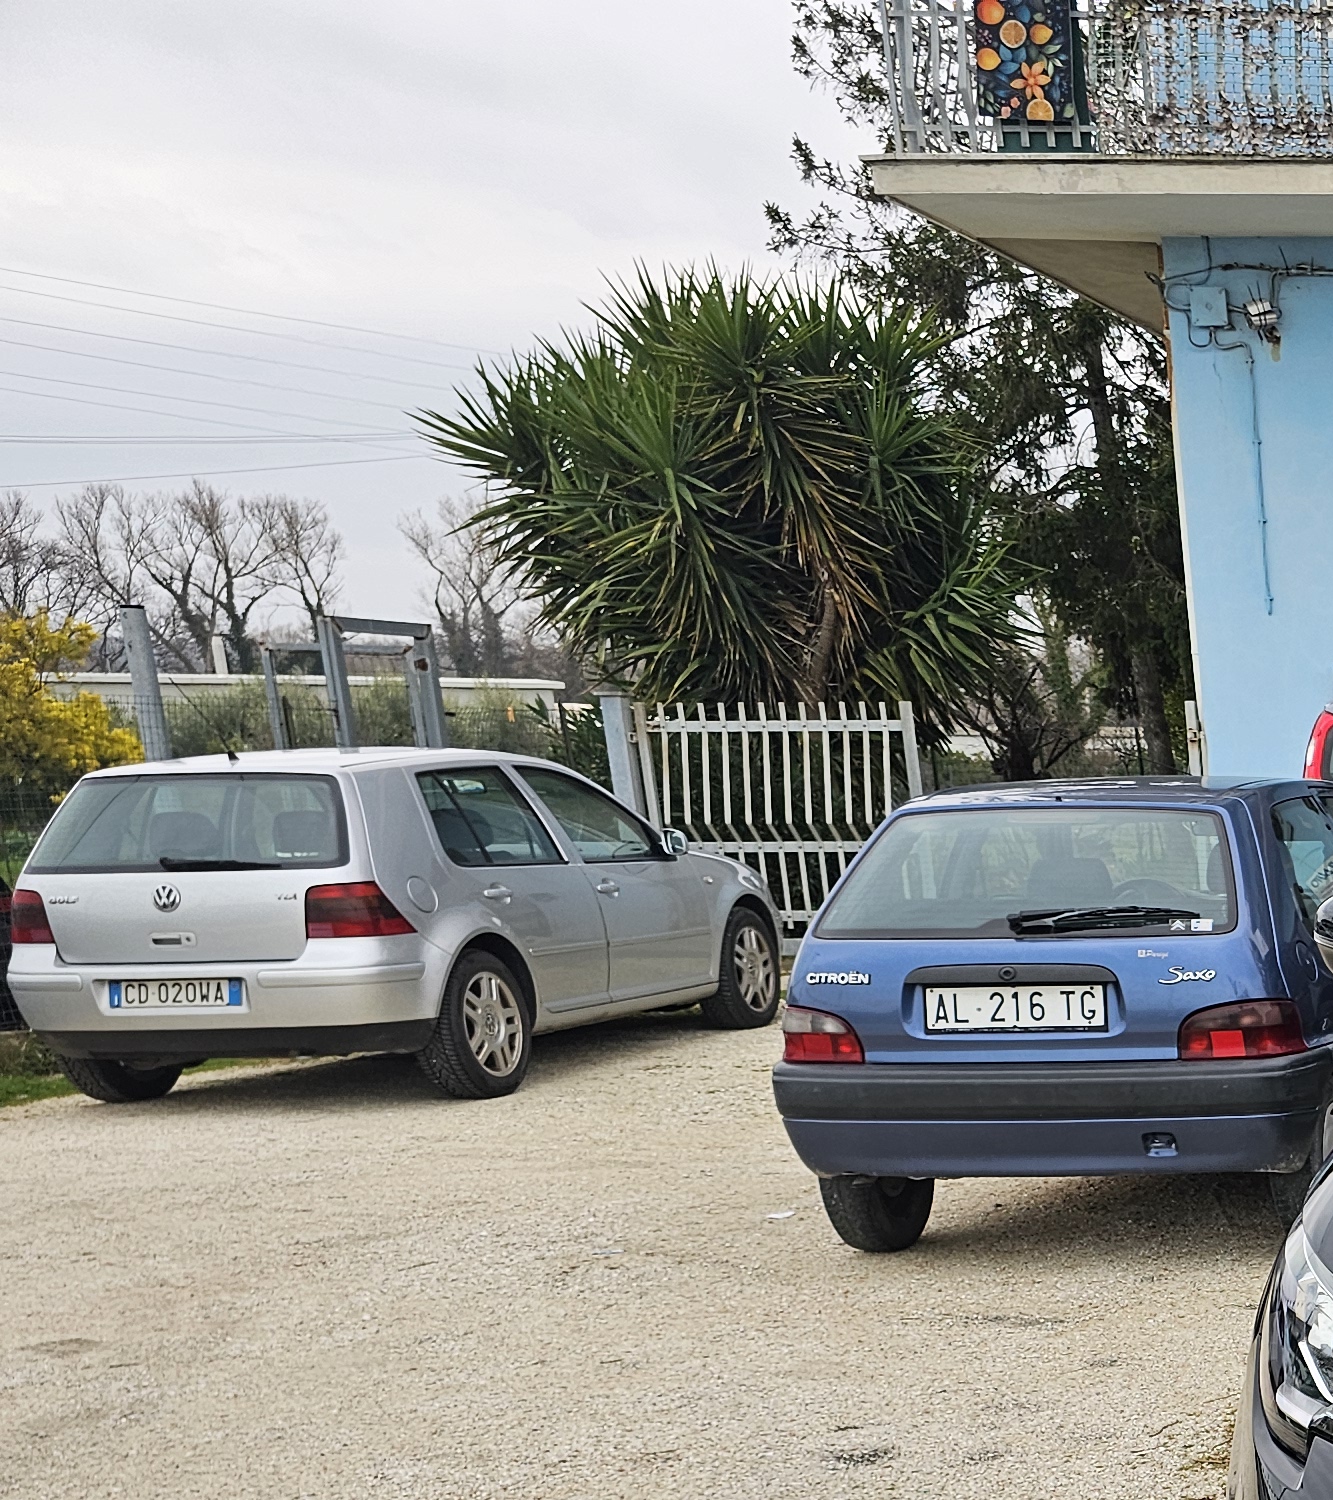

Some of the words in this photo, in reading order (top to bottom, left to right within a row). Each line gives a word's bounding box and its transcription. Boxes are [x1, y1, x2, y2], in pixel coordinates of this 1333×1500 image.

[805, 969, 872, 986] CITROËN
[1158, 965, 1217, 985] Saxo
[934, 992, 970, 1025] AL
[989, 991, 1046, 1023] 216
[1062, 989, 1097, 1022] TG
